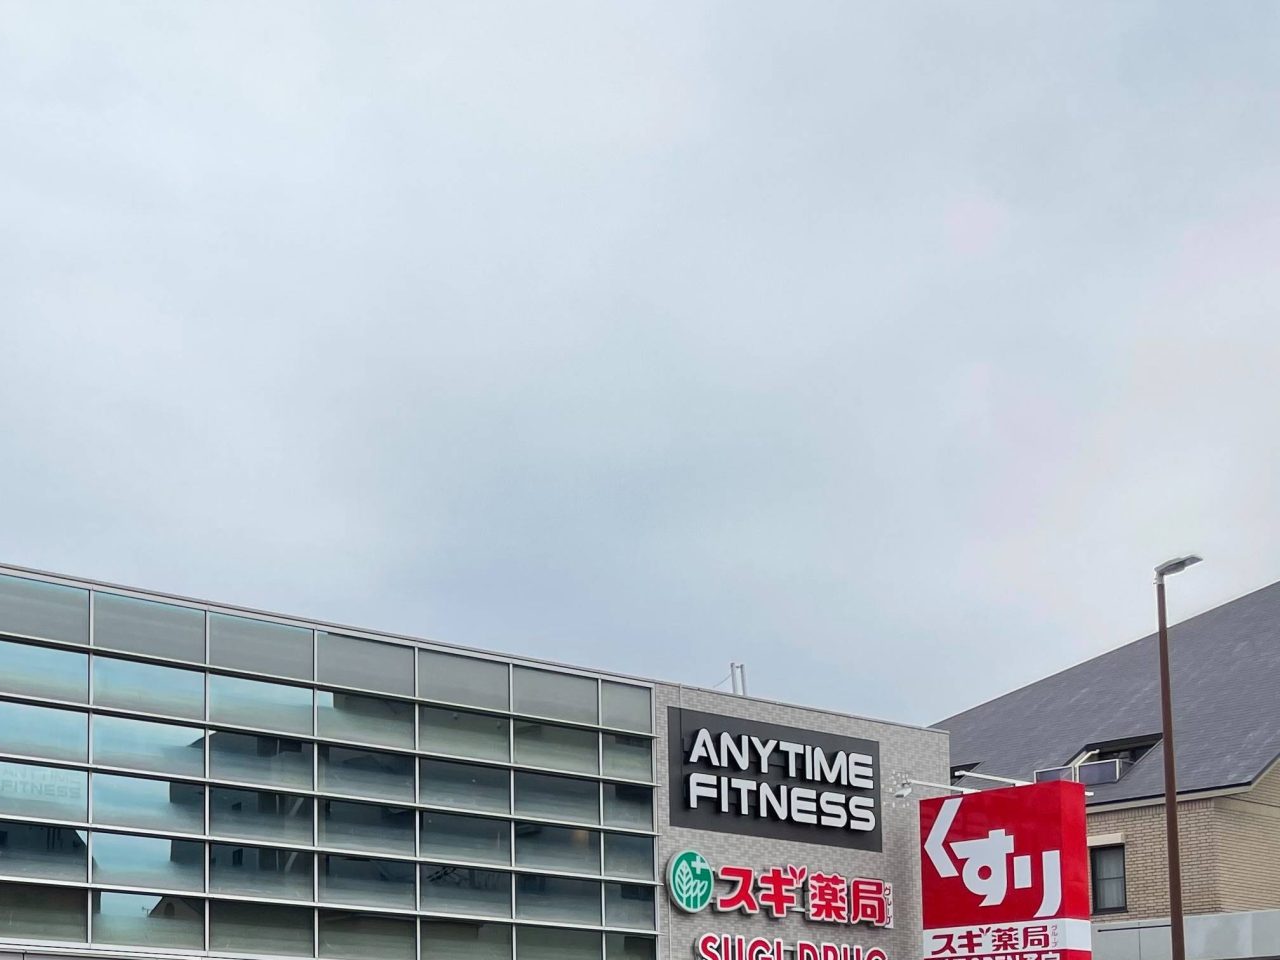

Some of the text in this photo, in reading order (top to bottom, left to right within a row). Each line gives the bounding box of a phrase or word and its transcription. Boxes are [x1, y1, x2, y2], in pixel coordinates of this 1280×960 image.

[689, 728, 874, 789] ANYTIME
[1, 780, 81, 798] FITNESS
[689, 772, 876, 831] FITNESS
[923, 797, 1062, 918] くすり
[717, 864, 888, 927] スギ薬局
[931, 926, 1050, 956] スギ薬局
